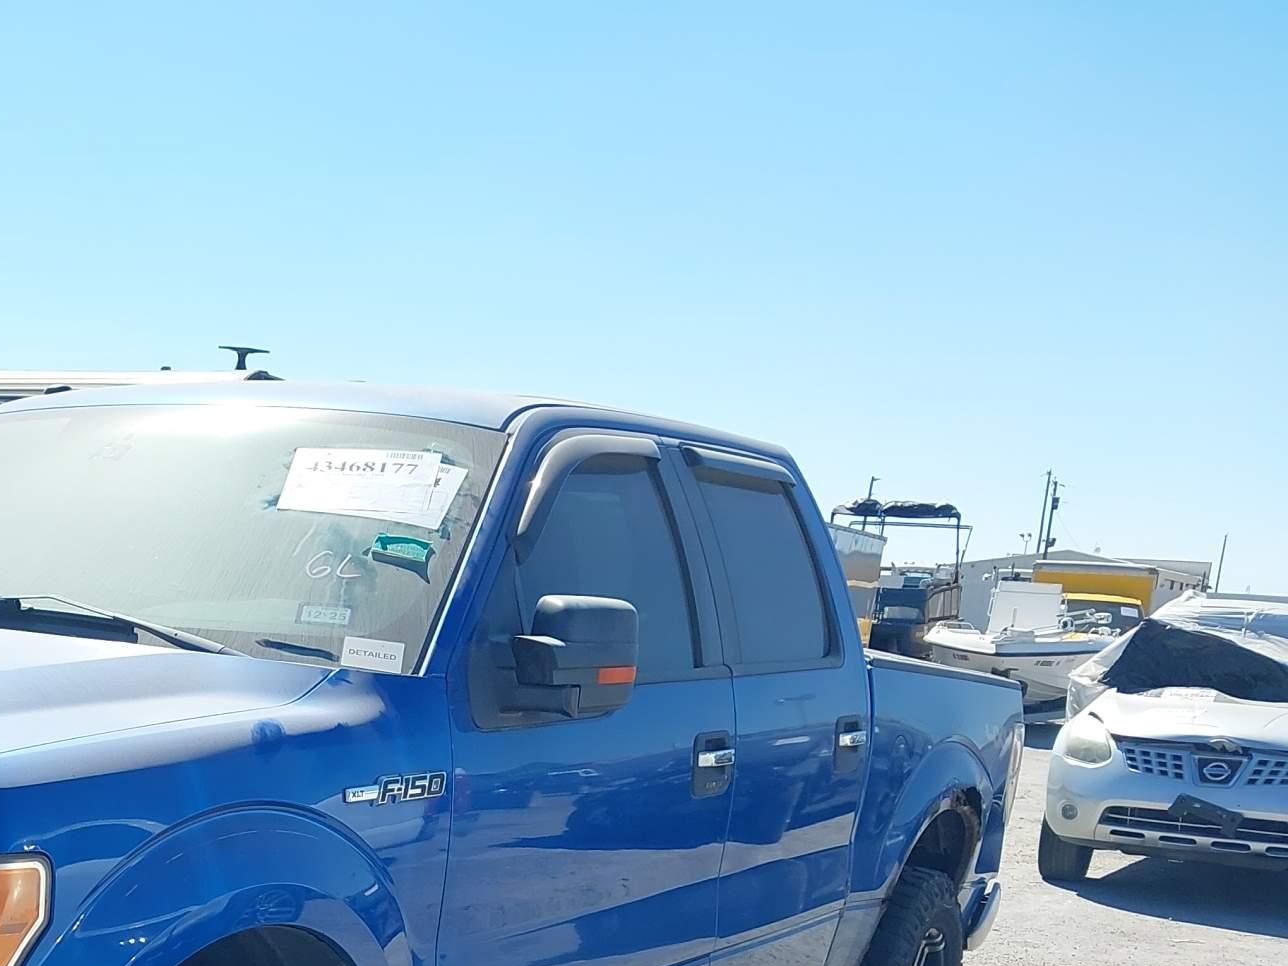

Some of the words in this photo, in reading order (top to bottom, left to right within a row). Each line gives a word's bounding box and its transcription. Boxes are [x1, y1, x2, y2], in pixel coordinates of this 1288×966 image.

[305, 460, 418, 475] 43468177
[348, 648, 397, 661] DETAILED
[351, 790, 365, 798] XLT
